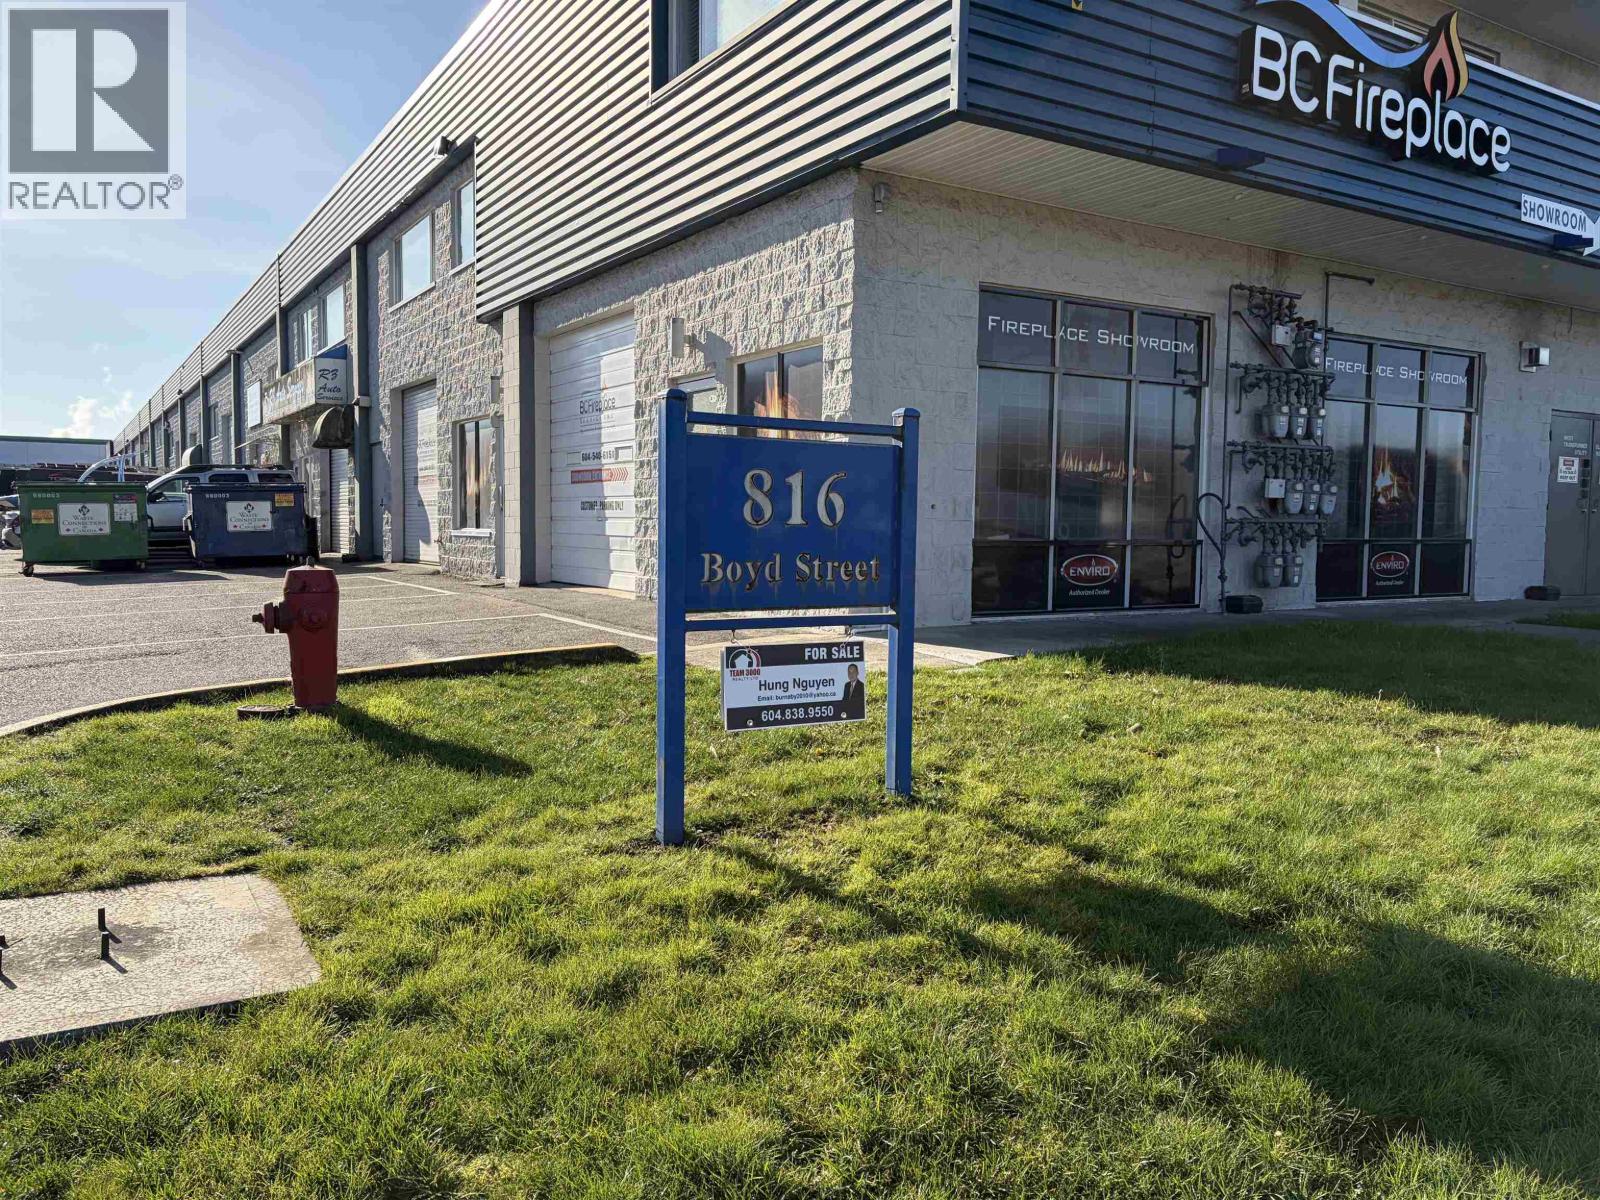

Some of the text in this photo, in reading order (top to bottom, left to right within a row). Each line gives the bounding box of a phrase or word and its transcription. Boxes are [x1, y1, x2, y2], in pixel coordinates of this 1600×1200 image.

[1522, 199, 1587, 233] SHOWROOM
[743, 468, 848, 528] 816
[700, 551, 881, 591] Boyd Street
[1069, 566, 1110, 576] ENVIRO
[804, 645, 860, 660] FOR SALE
[729, 668, 761, 678] TEAM 3000
[758, 677, 835, 692] Hung Nguyen
[757, 694, 774, 702] Email:
[761, 705, 834, 722] 604.838.9550
